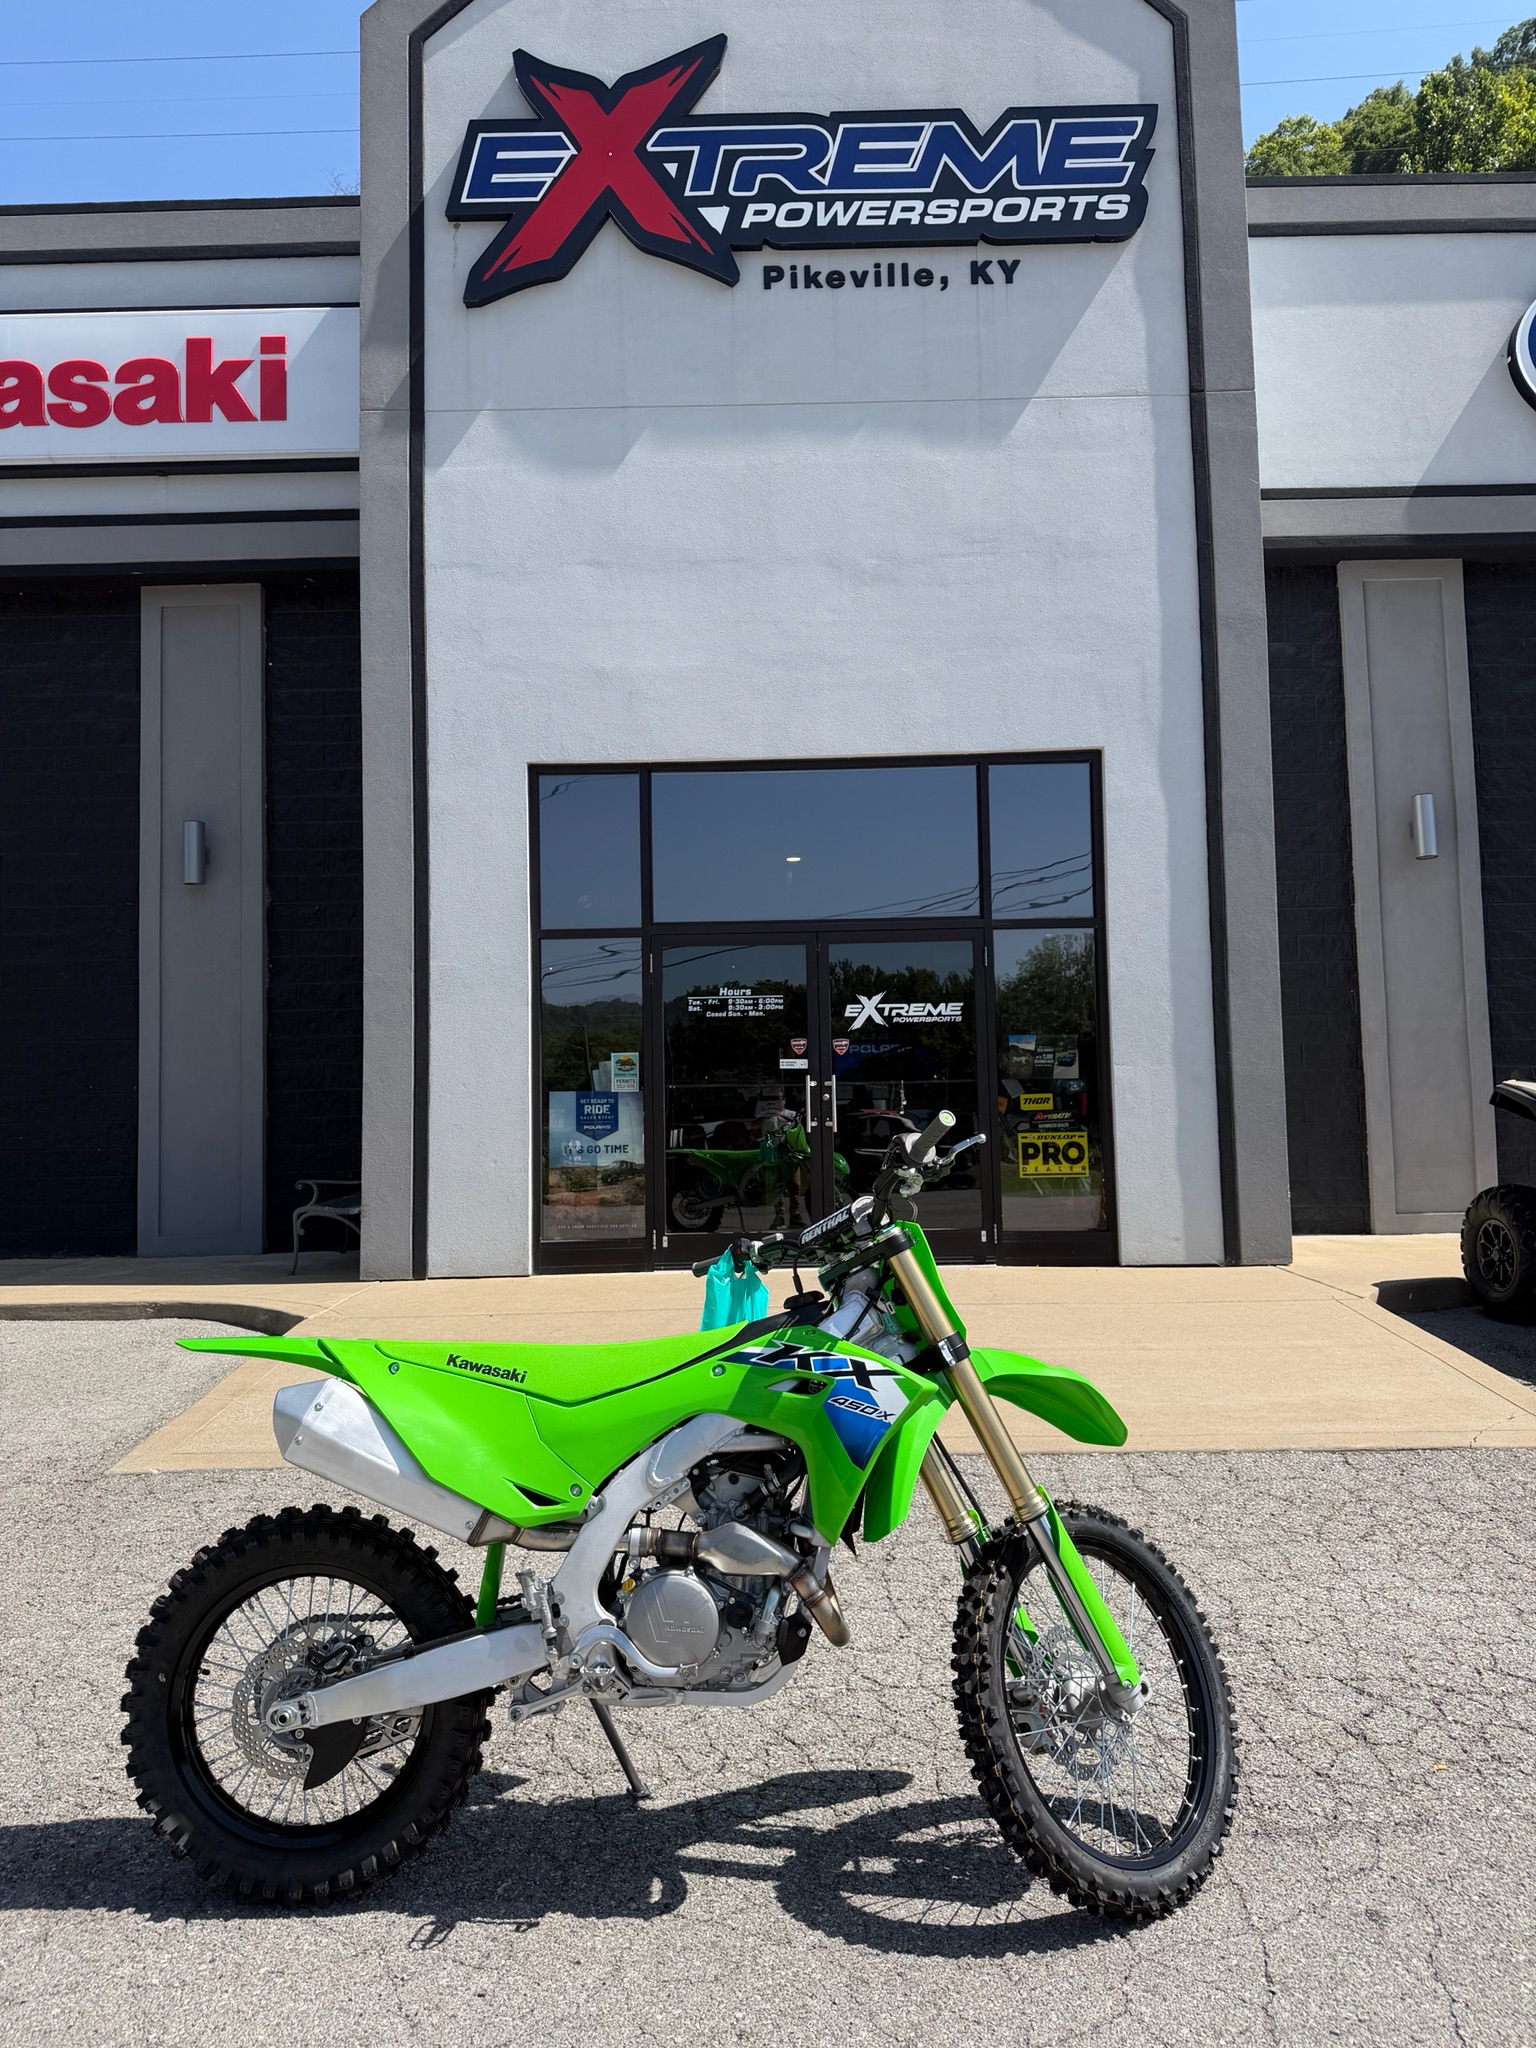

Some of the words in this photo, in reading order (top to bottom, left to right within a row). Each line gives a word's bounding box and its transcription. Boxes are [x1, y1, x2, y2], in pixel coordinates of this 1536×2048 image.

[460, 55, 1145, 282] EXTREME
[740, 192, 1131, 229] POWERSPORTS
[762, 260, 950, 292] Pikeville,
[970, 259, 1022, 285] KY
[719, 987, 752, 996] Hours
[844, 990, 964, 1032] EXTREME
[584, 1104, 610, 1114] RIDE
[1023, 1097, 1051, 1105] THOR
[587, 1145, 601, 1154] GO
[604, 1144, 629, 1153] TIME
[1022, 1141, 1085, 1165] PRO
[801, 1210, 849, 1245] RENTHAL
[446, 1354, 528, 1384] Kawasaki
[751, 1340, 903, 1392] KX
